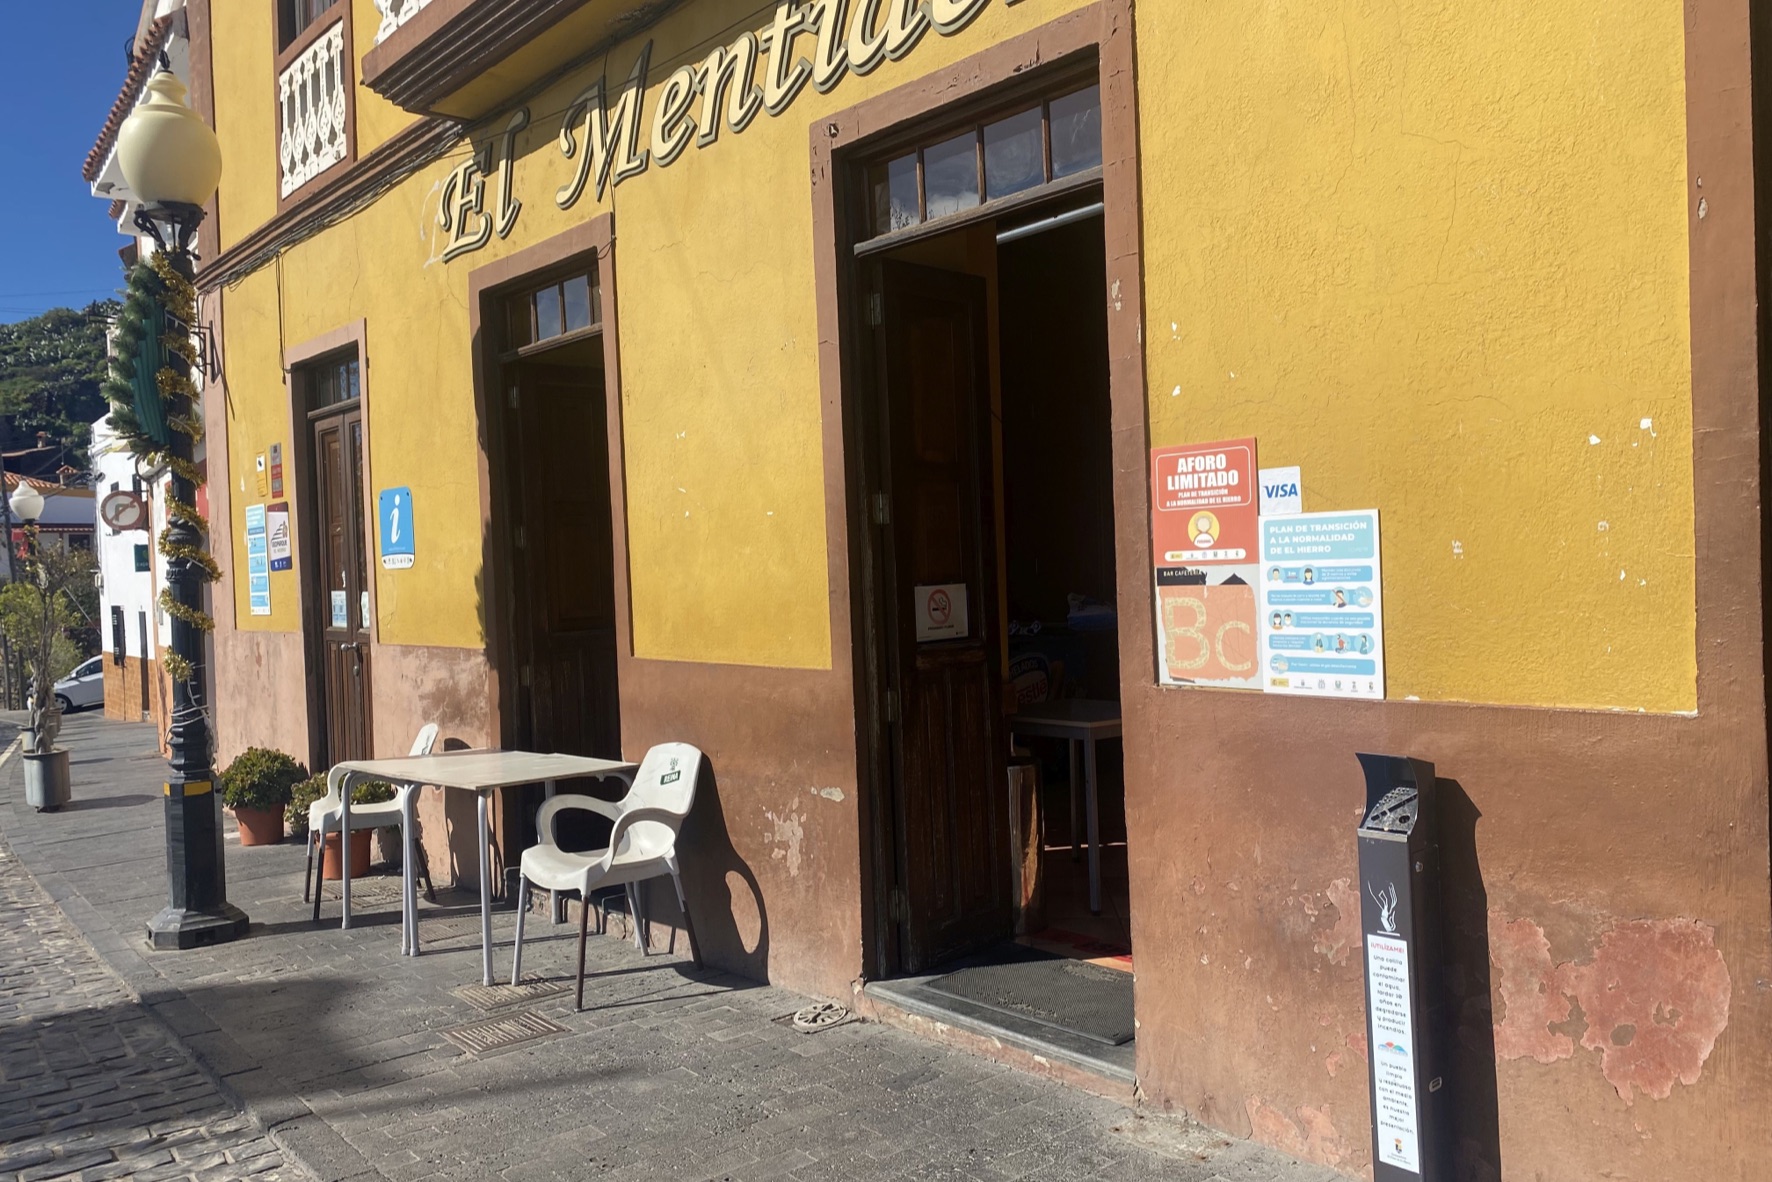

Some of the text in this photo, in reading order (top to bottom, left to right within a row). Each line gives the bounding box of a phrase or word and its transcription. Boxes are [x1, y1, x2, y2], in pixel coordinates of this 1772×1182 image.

[439, 106, 532, 264] El
[1177, 453, 1226, 474] AFORO
[1167, 469, 1239, 491] LIMITADO
[1263, 482, 1298, 498] VISA
[1177, 498, 1208, 506] NORMALIDAD
[1310, 520, 1367, 532] TRANSICIÓN
[1293, 534, 1355, 543] NORMALIDAD
[1165, 597, 1252, 672] Bc
[1373, 972, 1405, 982] contaminar
[1376, 1006, 1406, 1017] degradarse
[1389, 1063, 1407, 1072] pueblo
[1386, 1071, 1403, 1079] limpio
[1396, 1090, 1412, 1099] medio
